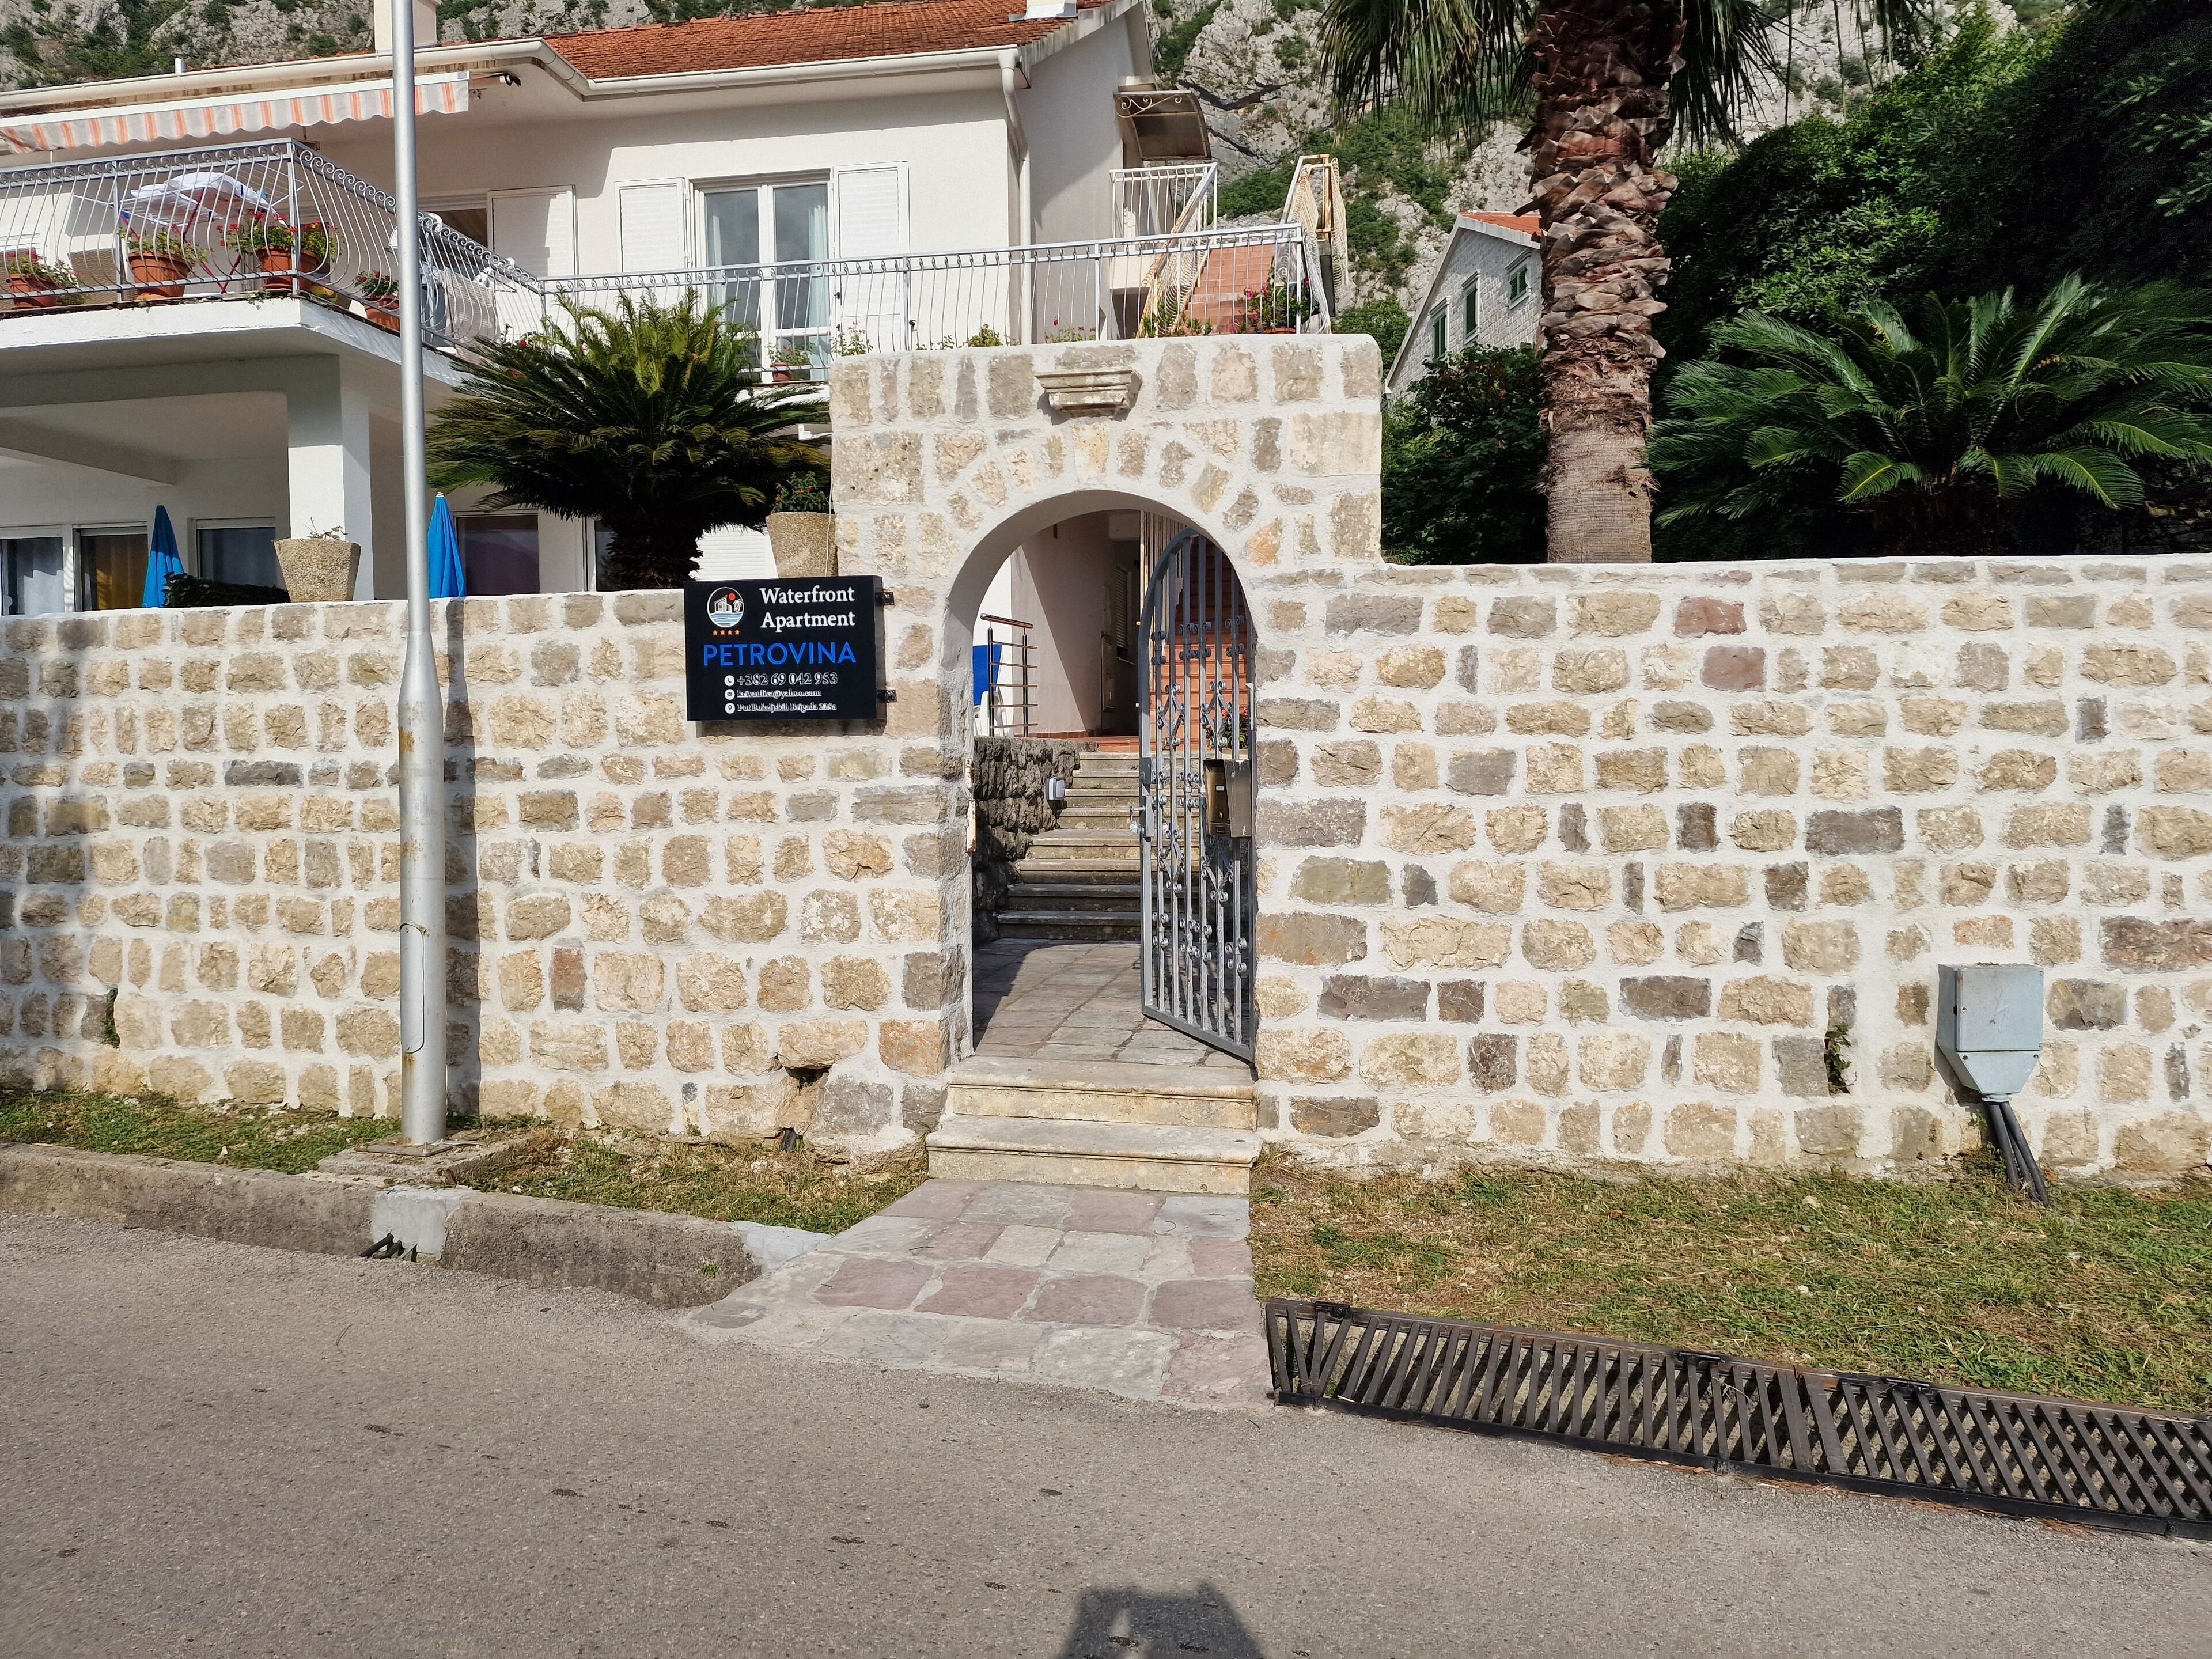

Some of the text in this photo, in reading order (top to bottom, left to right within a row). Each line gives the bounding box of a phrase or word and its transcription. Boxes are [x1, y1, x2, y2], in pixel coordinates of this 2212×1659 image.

[759, 585, 855, 604] Waterfront
[760, 611, 855, 632] Apartment
[703, 641, 857, 666] PETROVINA
[737, 672, 838, 685] +382 69 042 953
[737, 703, 751, 711] Put
[790, 702, 818, 713] Brigada
